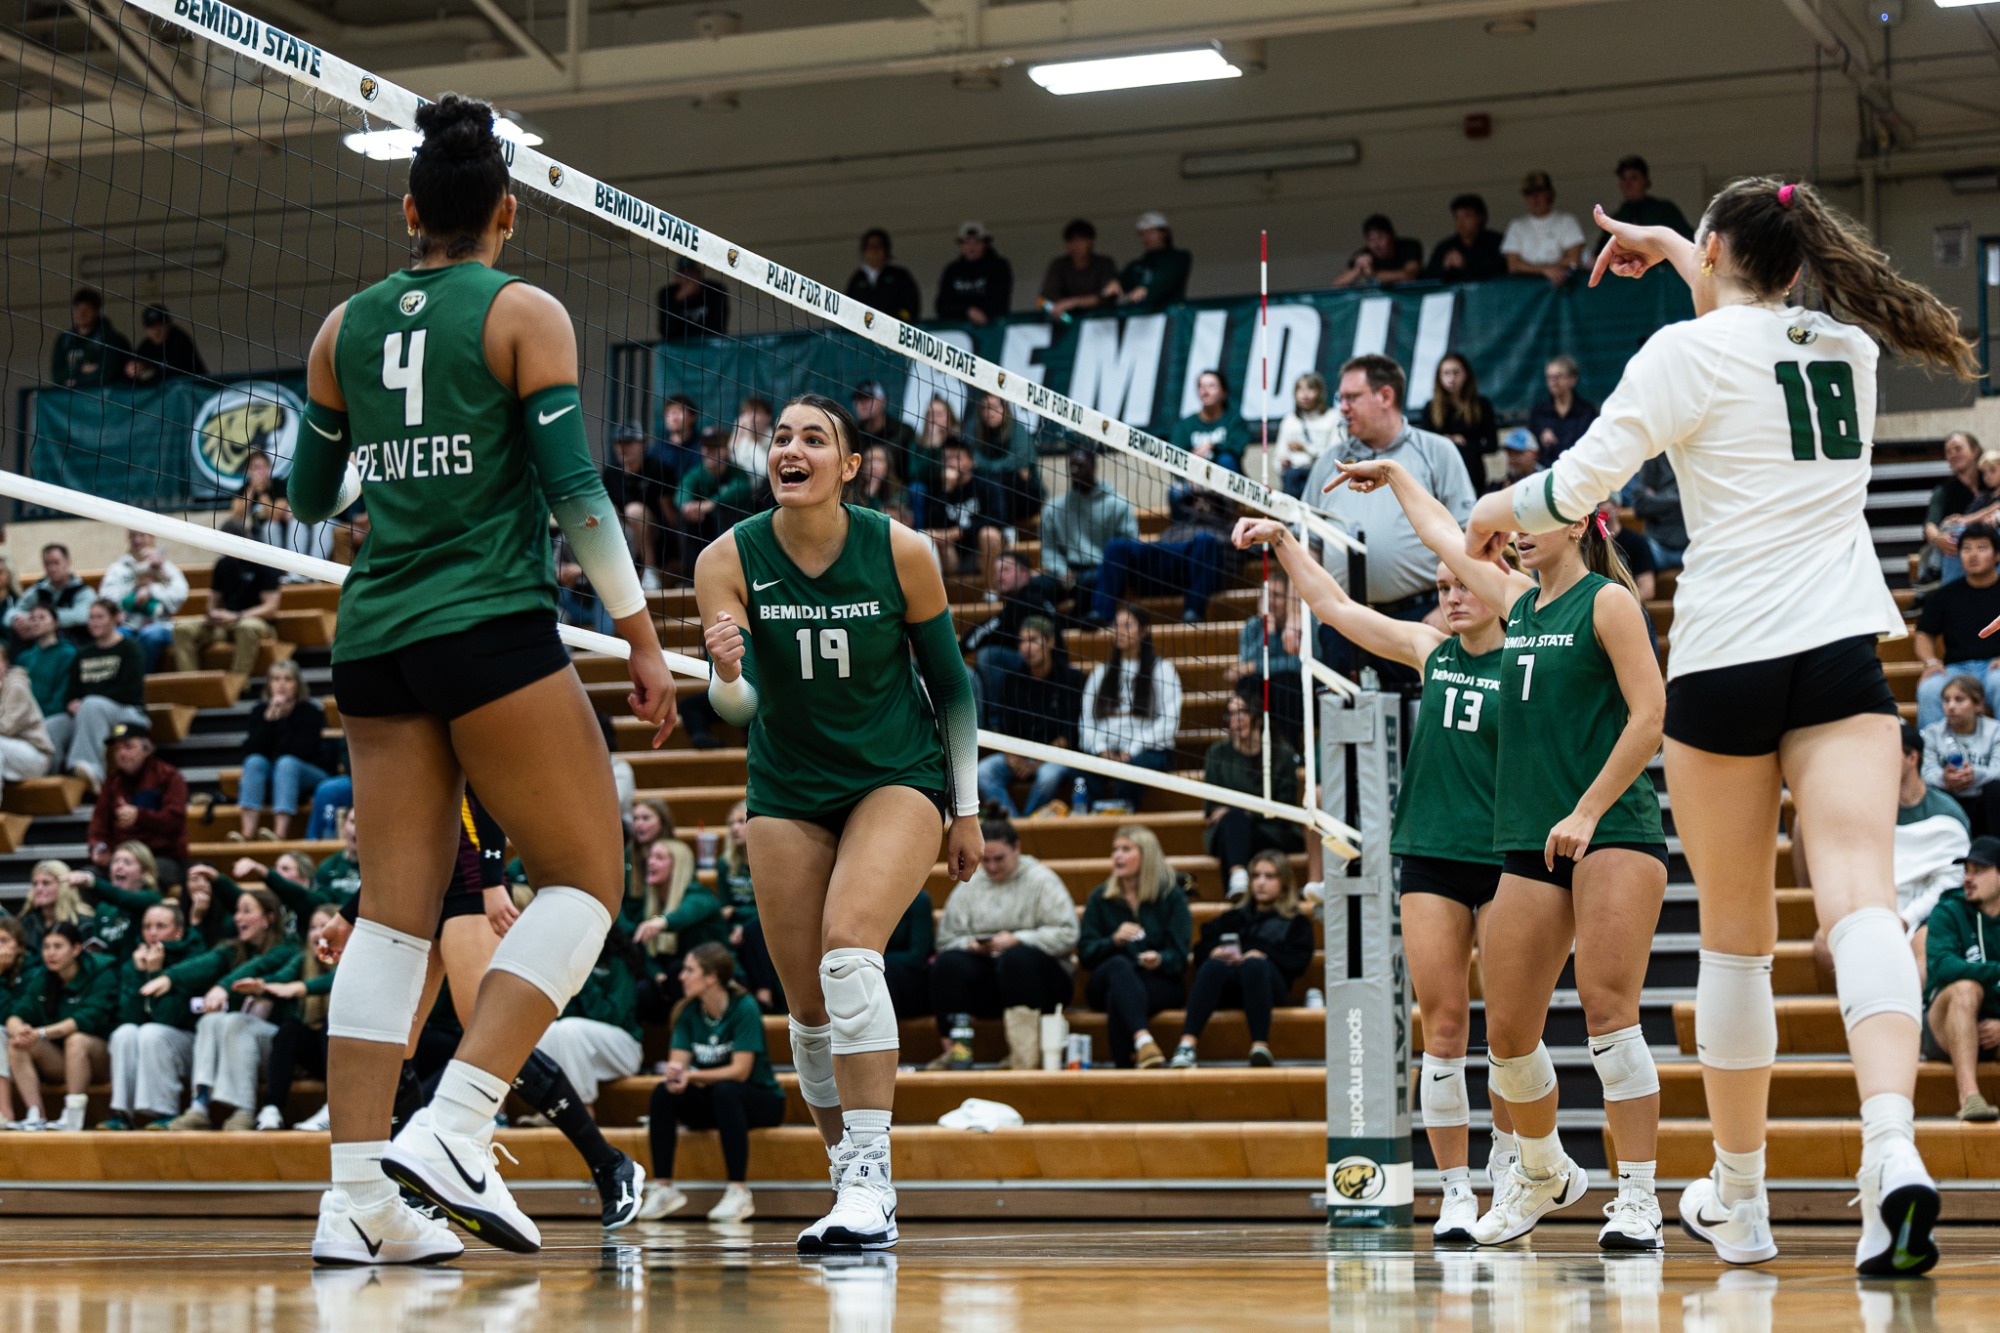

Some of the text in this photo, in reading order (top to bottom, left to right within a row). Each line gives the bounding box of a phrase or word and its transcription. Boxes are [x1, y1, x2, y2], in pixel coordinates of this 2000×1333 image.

[263, 26, 322, 78] STATE
[594, 182, 699, 252] BEMIDJI STATE
[766, 261, 839, 315] PLAY FOR KU
[898, 322, 976, 377] BEMIDJI STATE
[382, 328, 427, 427] 4
[1027, 382, 1083, 425] PLAY FOR KU
[1774, 360, 1863, 461] 18
[356, 434, 473, 483] BEAVERS
[1128, 428, 1163, 460] BEMIDJI
[1164, 444, 1188, 471] STATE
[759, 601, 881, 620] BEMIDJI STATE
[795, 627, 850, 680] 19
[1536, 633, 1574, 647] STATE
[1475, 677, 1501, 691] STA
[1516, 652, 1536, 701] 7
[1442, 686, 1485, 733] 13
